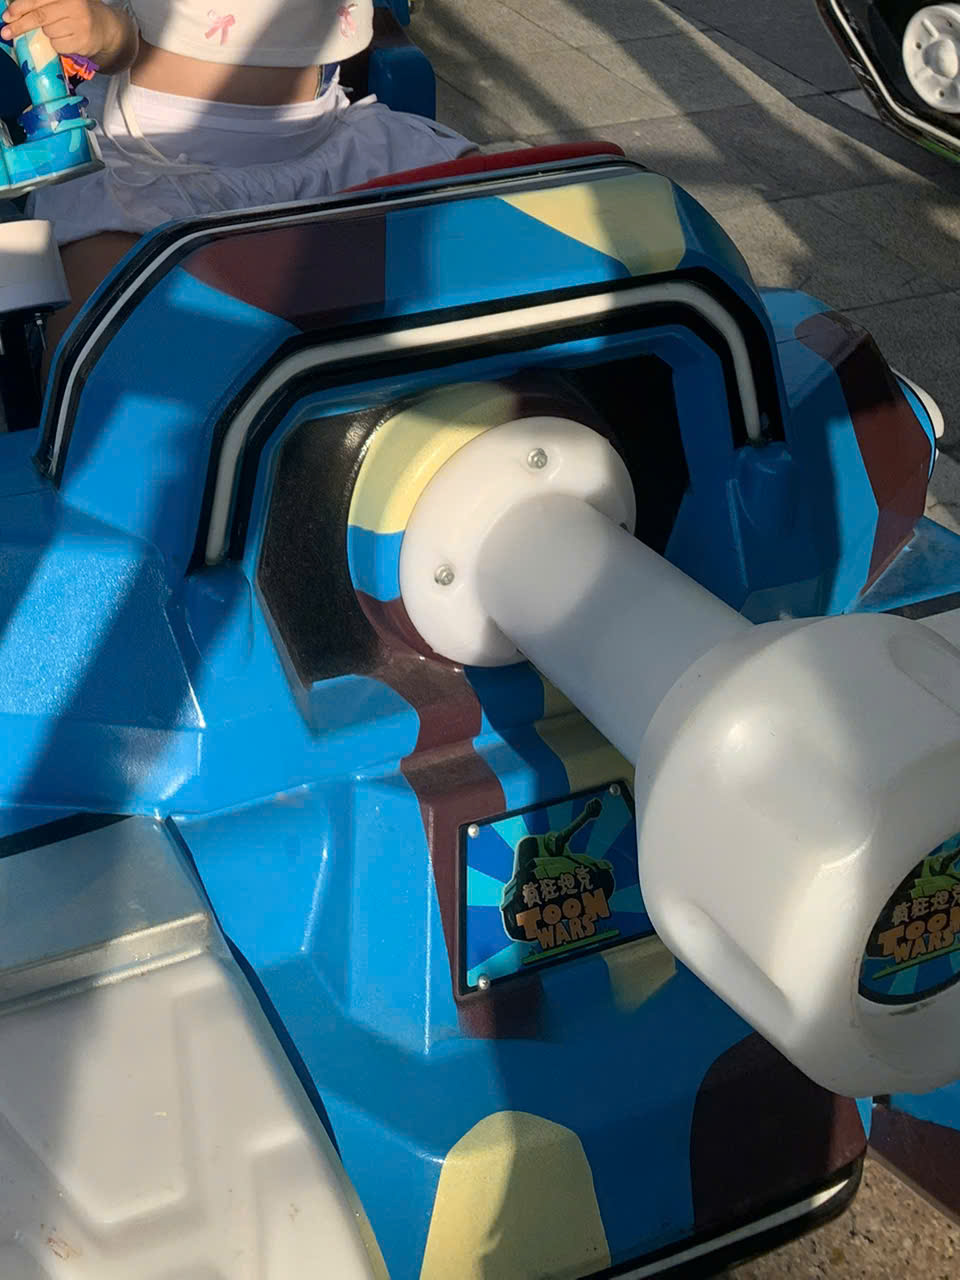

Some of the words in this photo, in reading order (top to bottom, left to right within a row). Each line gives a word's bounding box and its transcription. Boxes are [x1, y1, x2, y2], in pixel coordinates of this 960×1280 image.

[516, 888, 610, 939] TOON
[537, 914, 595, 949] WARS
[895, 928, 954, 963] WARS
